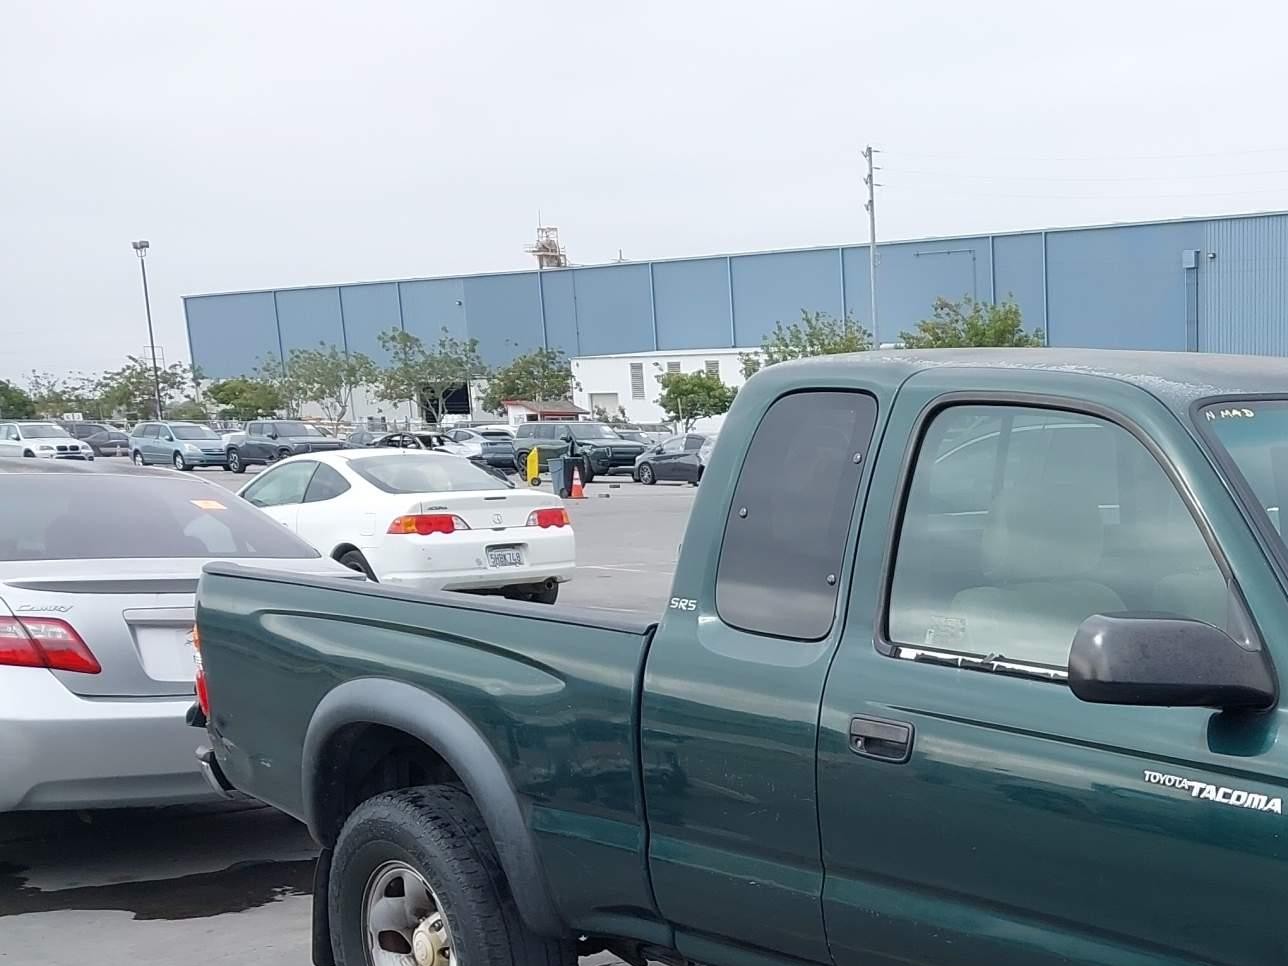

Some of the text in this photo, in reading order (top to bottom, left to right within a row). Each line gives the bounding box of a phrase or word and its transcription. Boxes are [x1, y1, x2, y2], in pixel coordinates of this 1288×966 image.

[670, 597, 697, 611] SR5
[1144, 770, 1282, 814] TOYOTA TACOMA
